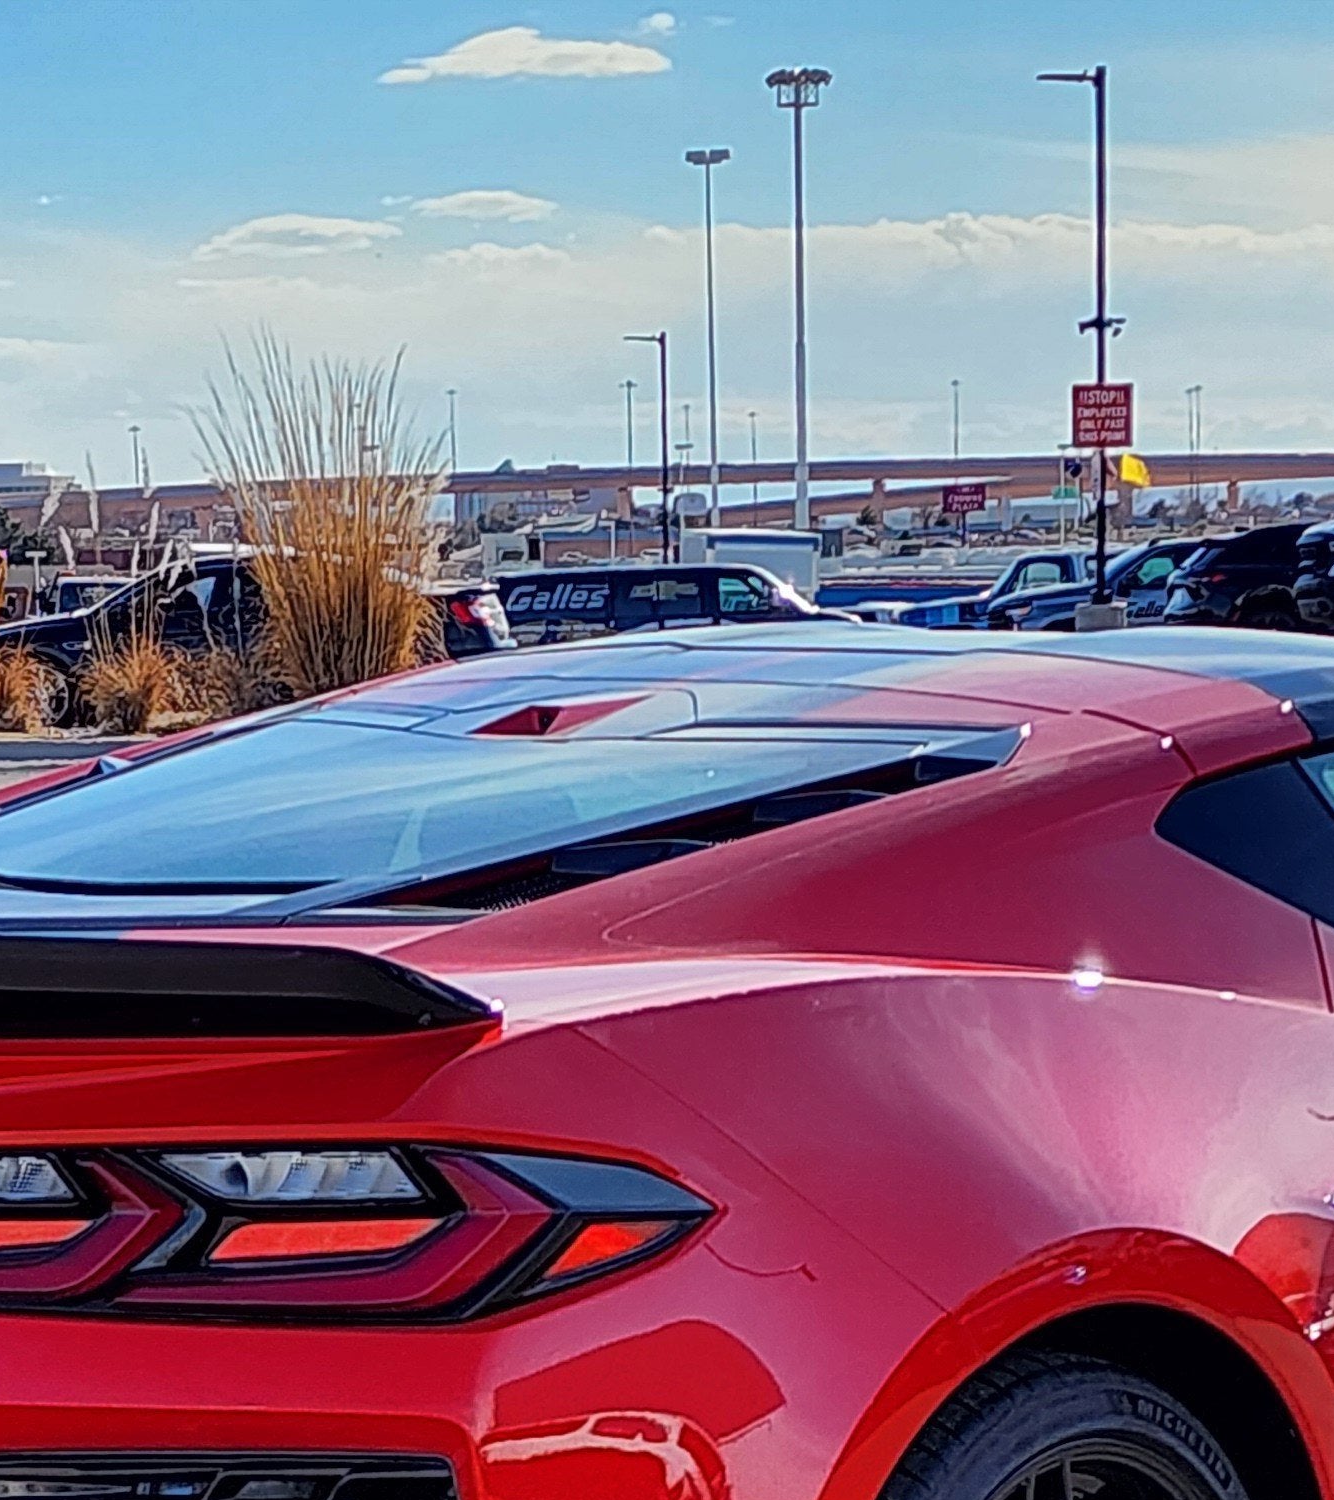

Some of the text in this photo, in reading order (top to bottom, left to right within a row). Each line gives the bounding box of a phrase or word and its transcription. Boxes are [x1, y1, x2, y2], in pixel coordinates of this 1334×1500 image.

[1079, 418, 1126, 430] ONLY PAST
[505, 582, 610, 612] Galles
[1137, 1398, 1227, 1481] MICHELIN
